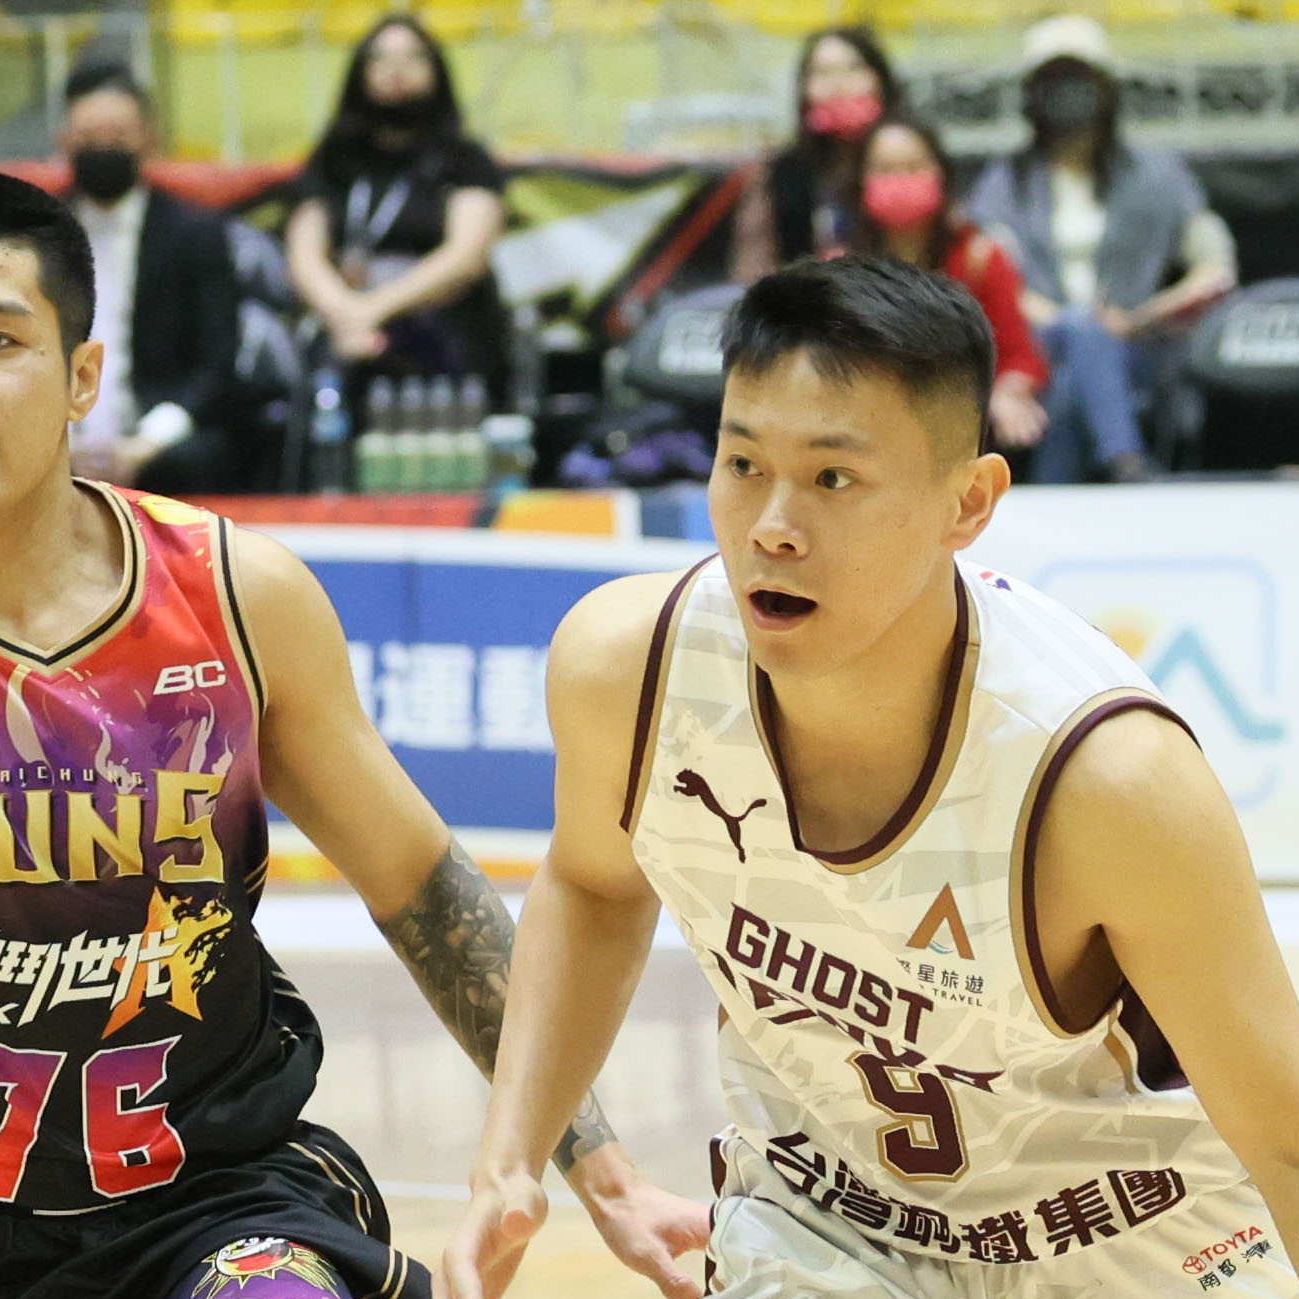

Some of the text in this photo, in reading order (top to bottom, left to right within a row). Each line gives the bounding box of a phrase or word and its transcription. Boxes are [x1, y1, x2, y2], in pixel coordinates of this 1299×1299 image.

[153, 660, 226, 695] BC
[349, 641, 554, 753] 運動
[726, 902, 934, 1044] GHOST
[933, 988, 983, 1007] TRAVEL
[846, 1050, 970, 1182] 9
[1200, 1226, 1263, 1262] TOYTA
